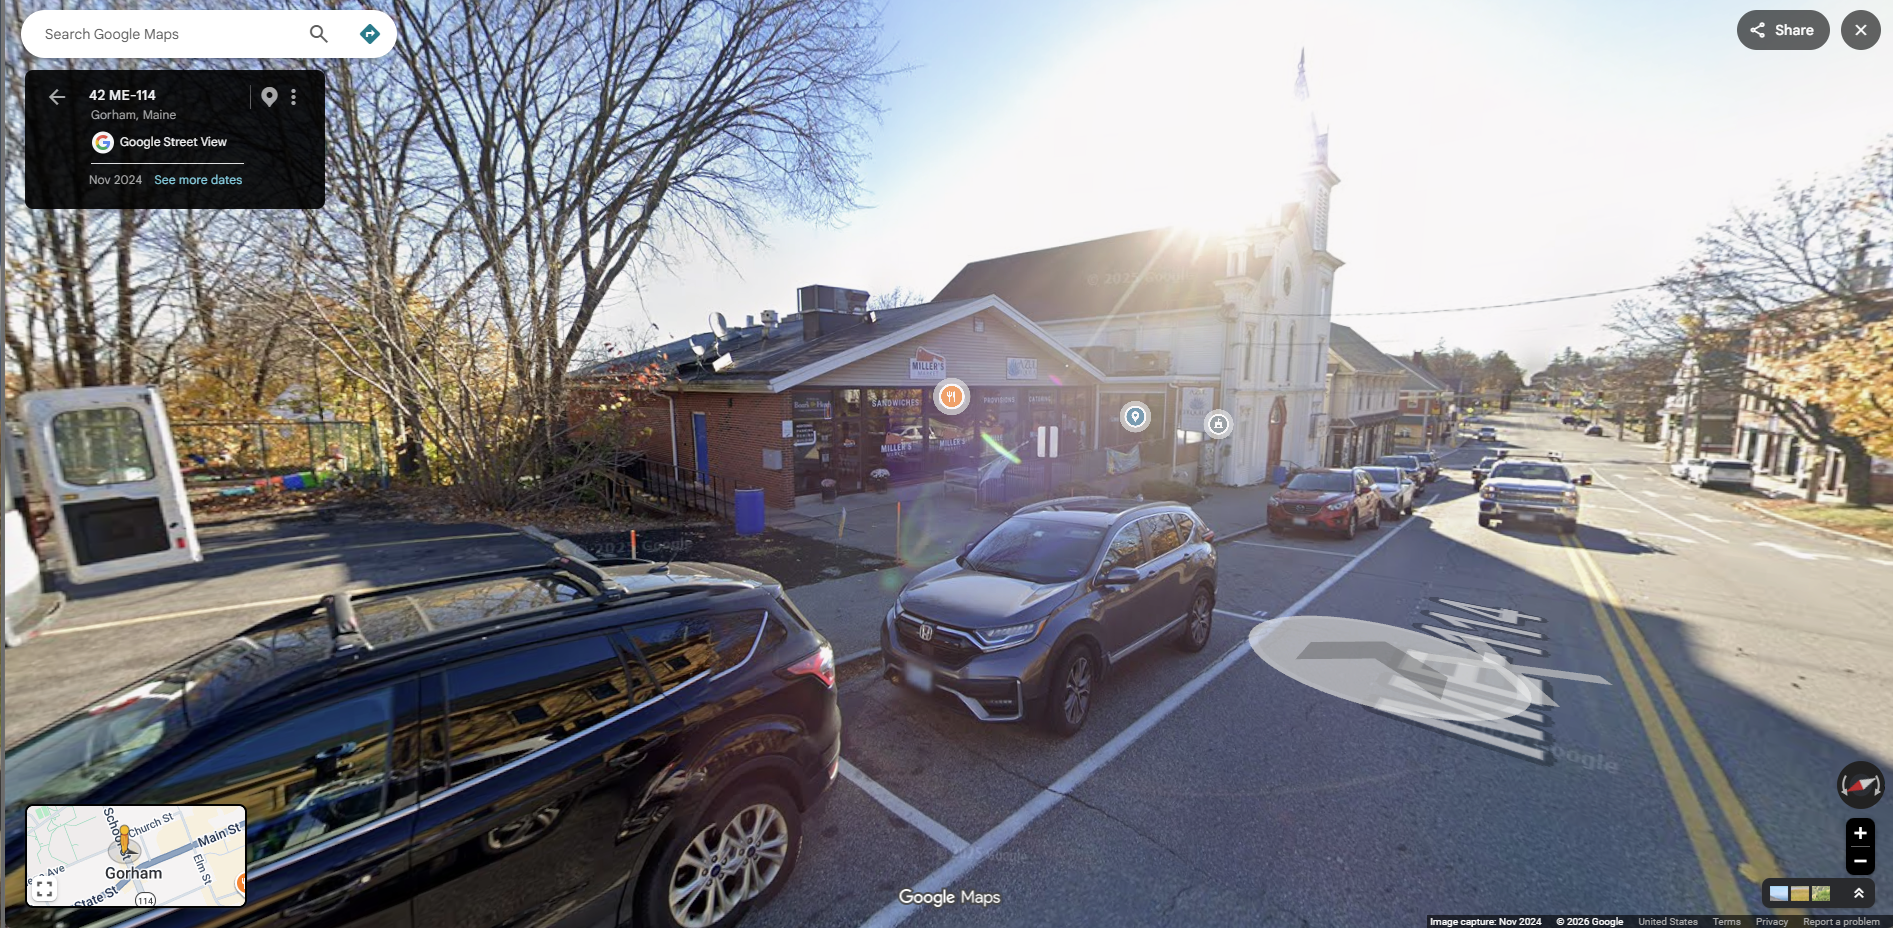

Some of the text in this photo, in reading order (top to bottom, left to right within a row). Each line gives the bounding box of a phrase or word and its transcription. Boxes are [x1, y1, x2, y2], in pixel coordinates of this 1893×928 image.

[912, 361, 945, 371] MILLER'S
[871, 398, 920, 408] SANDWICHES
[983, 396, 1016, 404] PROVISIONS
[1028, 395, 1052, 403] CATERING
[939, 438, 966, 447] MILLER'S
[880, 443, 912, 453] MILLER'S
